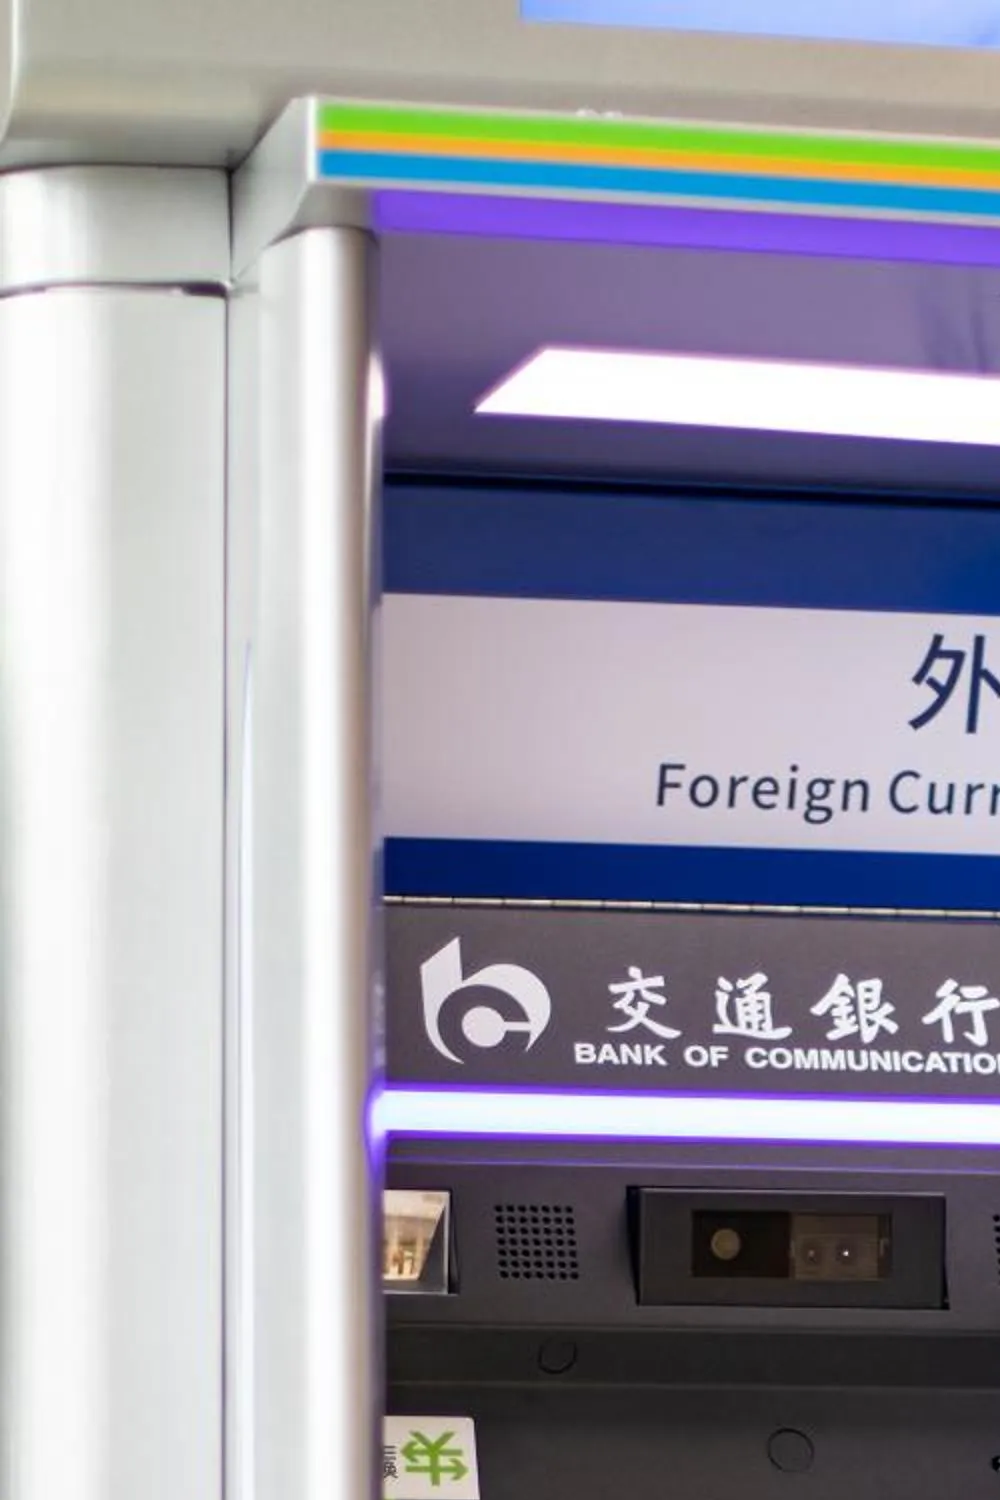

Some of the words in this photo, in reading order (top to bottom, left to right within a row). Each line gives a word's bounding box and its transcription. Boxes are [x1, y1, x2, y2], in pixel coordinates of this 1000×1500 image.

[655, 763, 870, 825] Foreign
[607, 966, 1000, 1046] 交通銀行
[574, 1042, 667, 1066] BANK
[684, 1046, 729, 1068] OF
